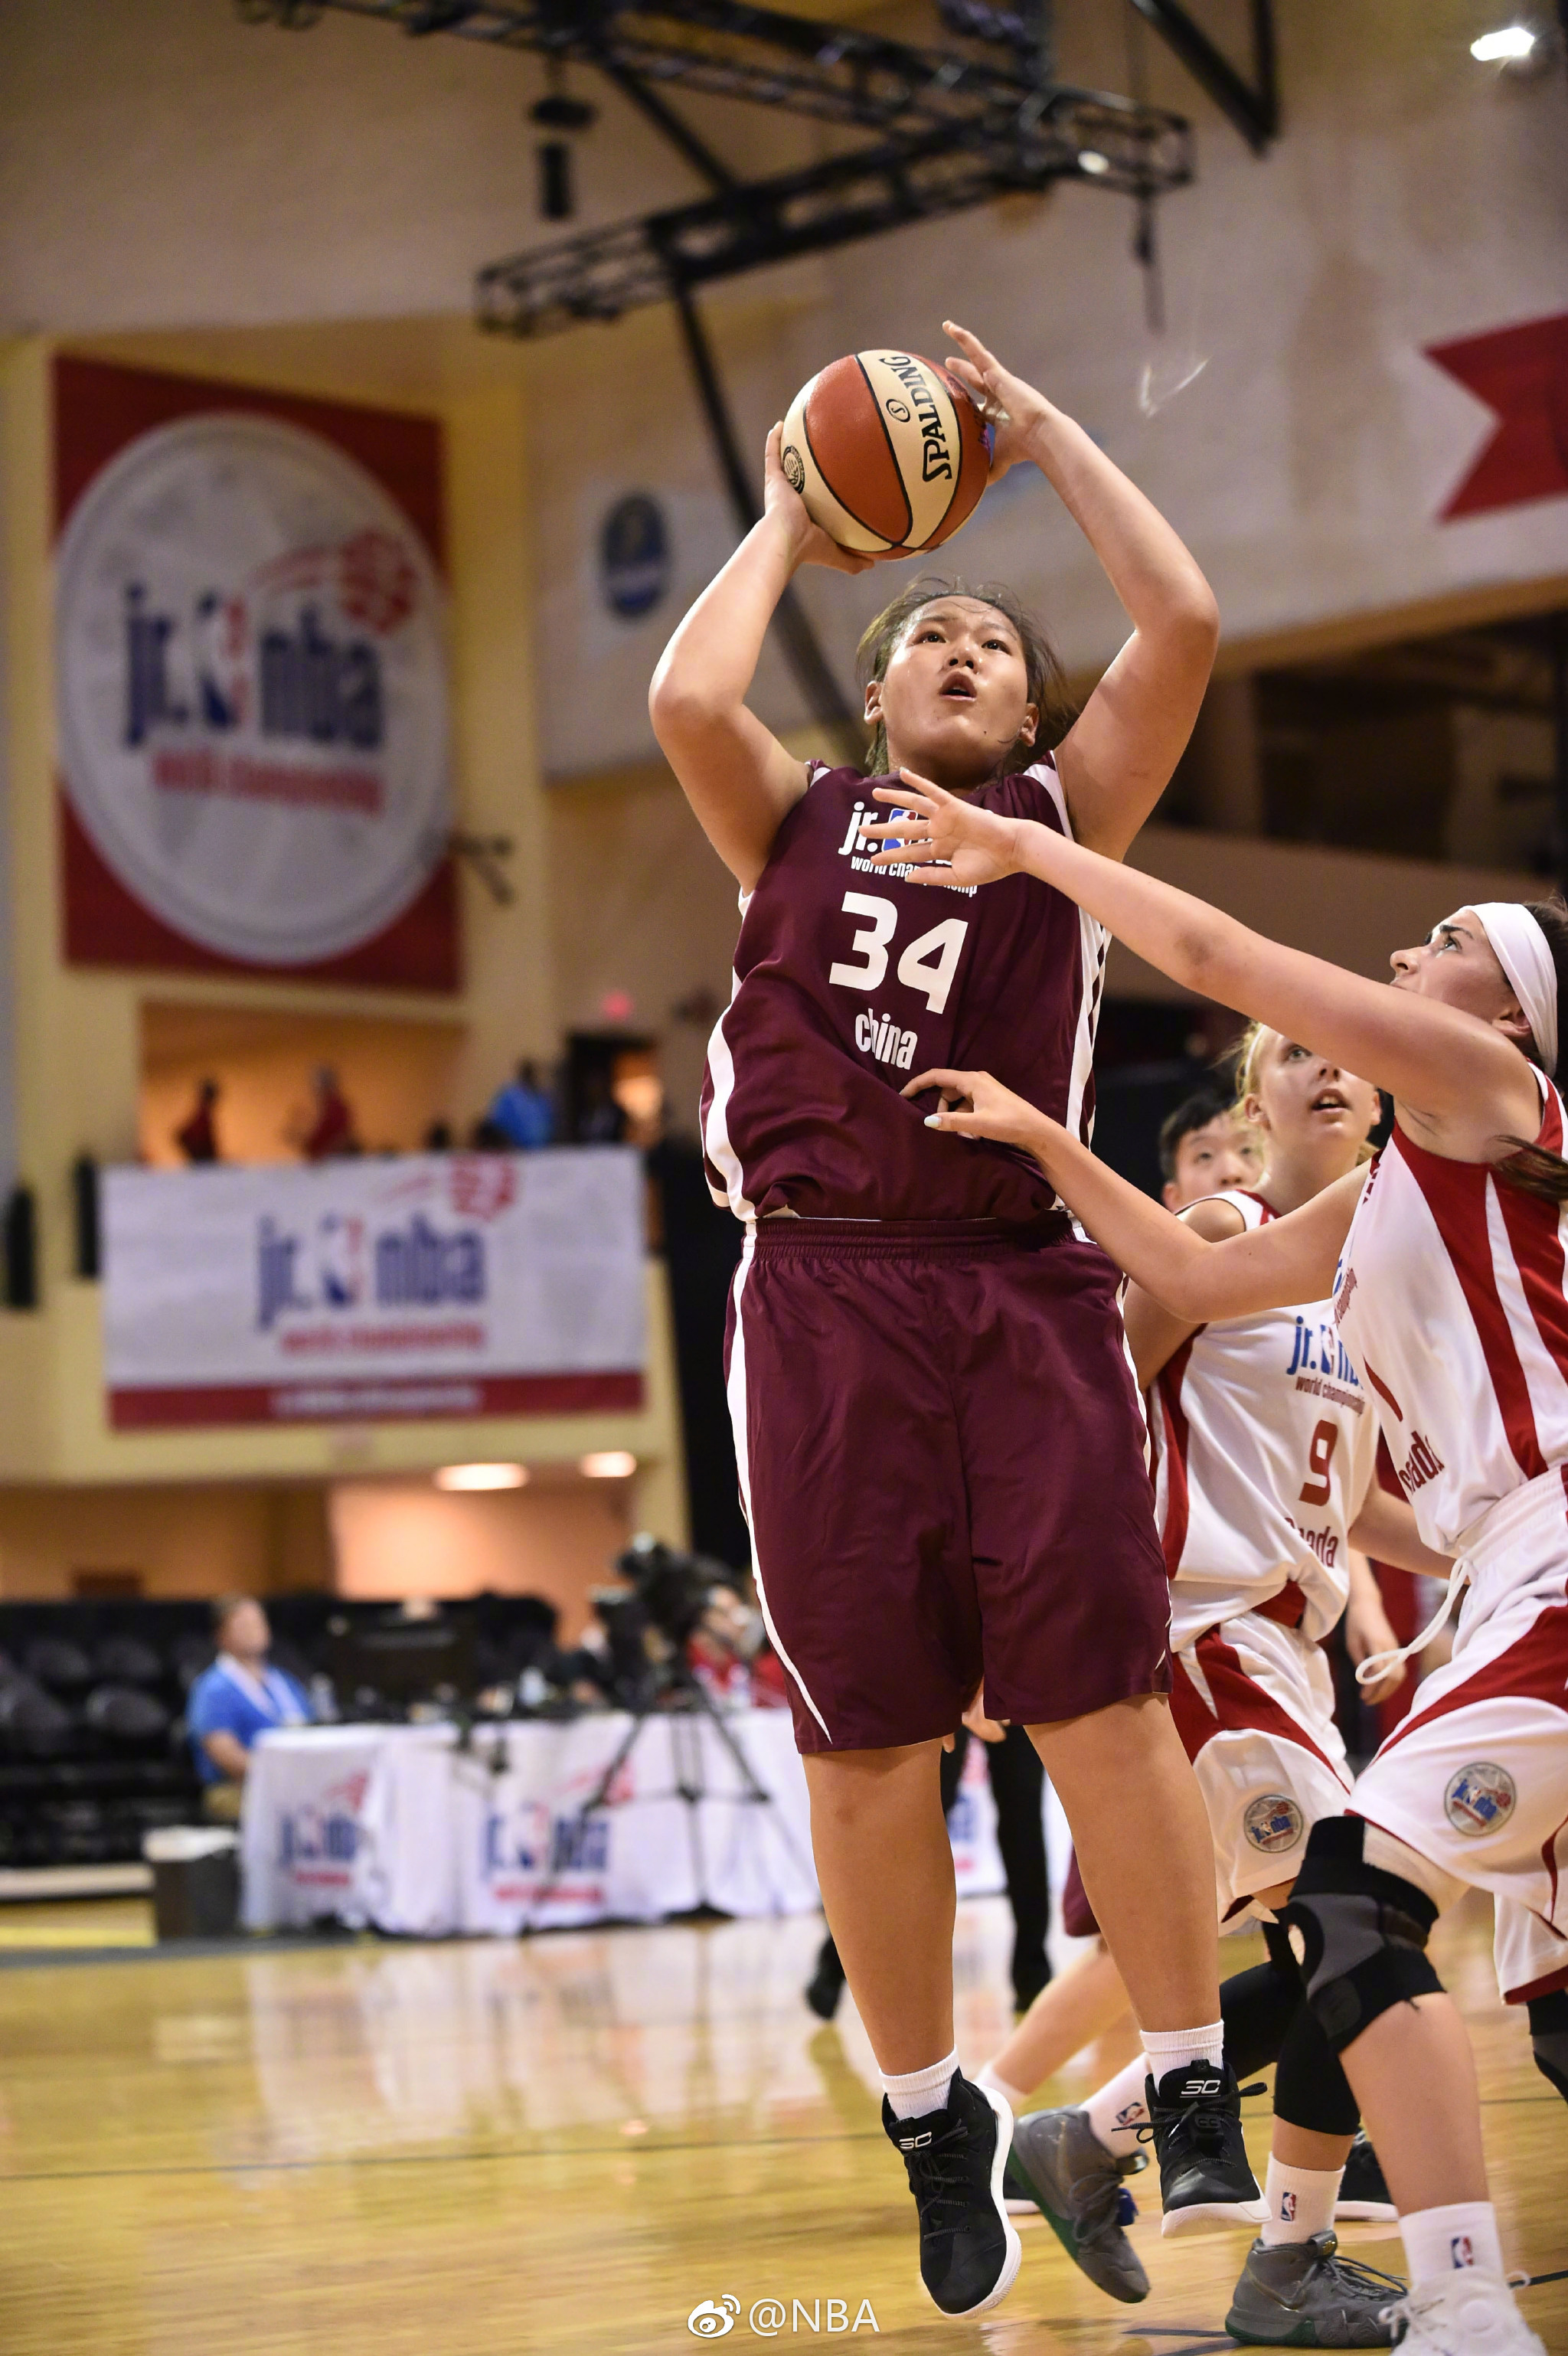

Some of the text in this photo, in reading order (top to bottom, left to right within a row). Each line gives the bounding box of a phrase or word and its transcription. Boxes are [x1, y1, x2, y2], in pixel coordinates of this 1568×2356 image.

[878, 356, 952, 482] SPALDING
[838, 801, 878, 855] jr.
[829, 891, 969, 1014] 34
[854, 1008, 918, 1070] china
[1286, 1315, 1316, 1375] jr.
[1298, 1420, 1338, 1507] 9
